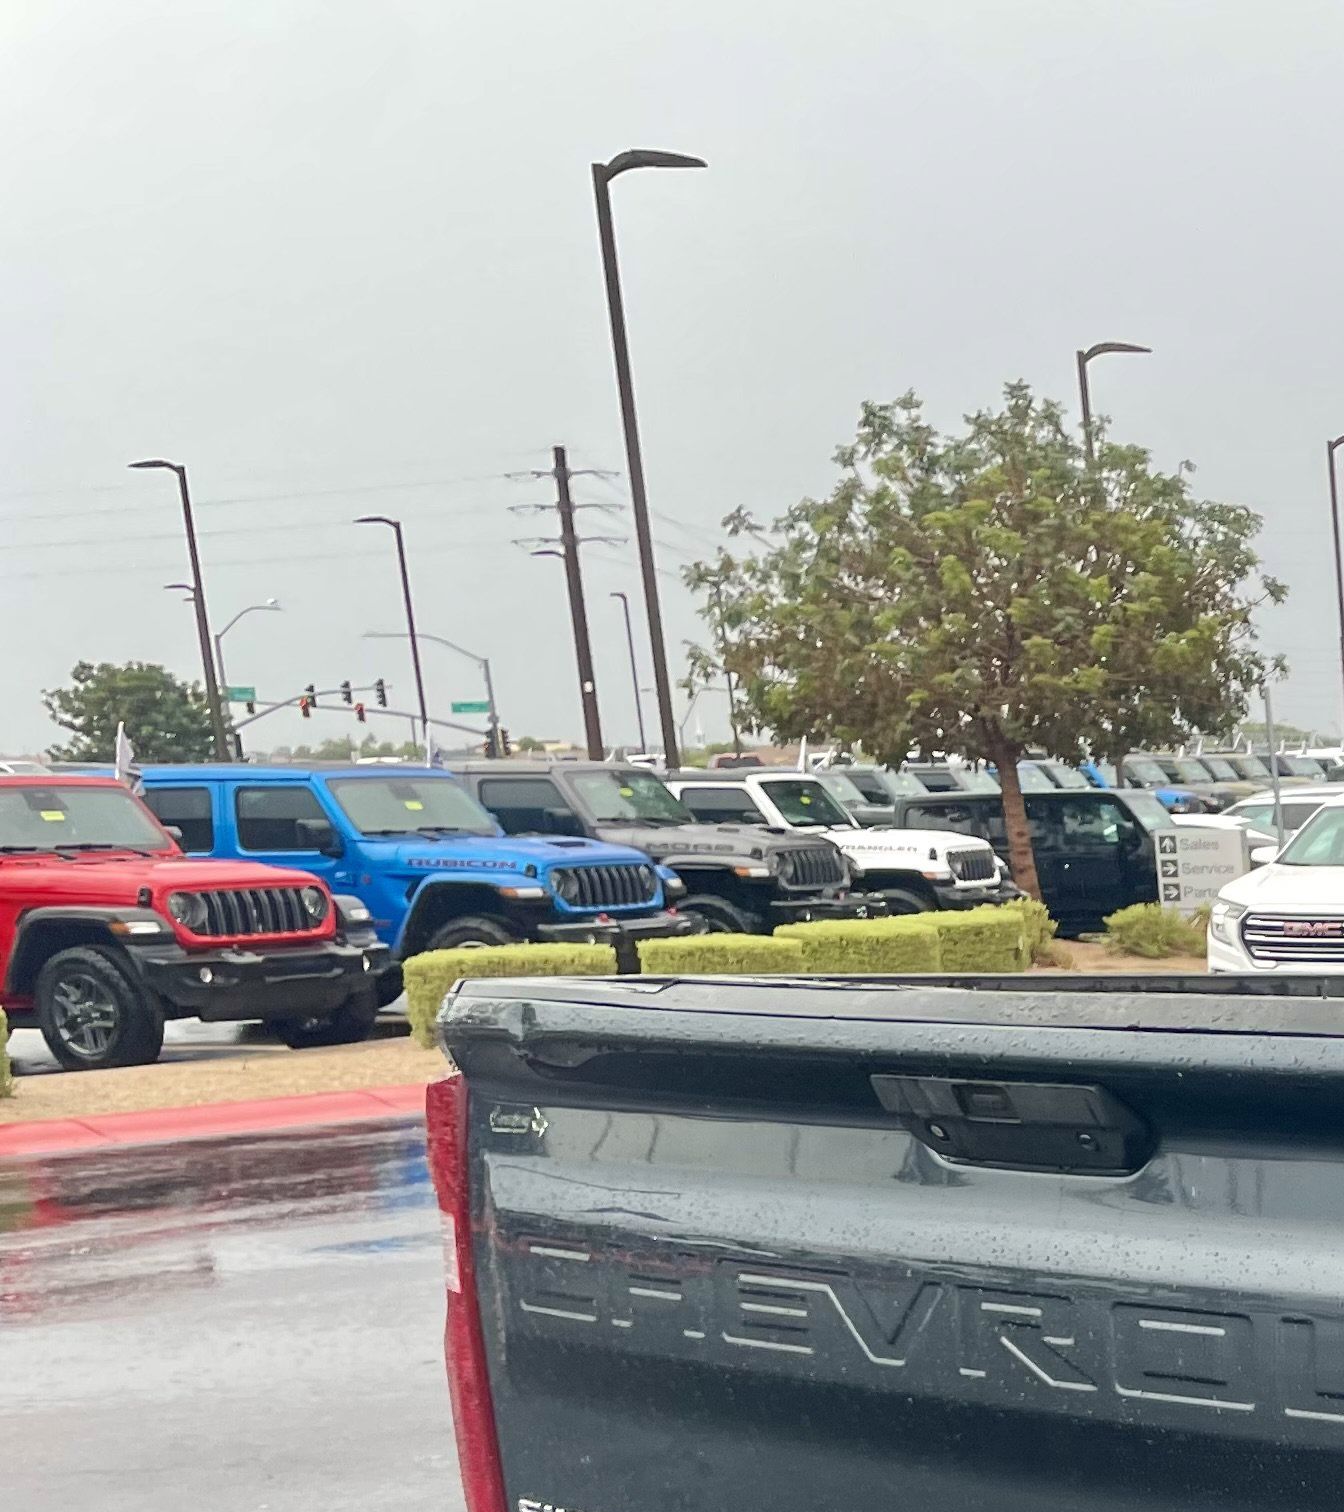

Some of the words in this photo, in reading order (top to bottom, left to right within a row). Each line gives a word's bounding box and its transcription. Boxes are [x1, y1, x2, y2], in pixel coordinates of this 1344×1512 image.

[1180, 838, 1219, 850] Sales
[407, 858, 517, 869] RUBICON
[1181, 862, 1234, 874] Service
[1284, 922, 1343, 937] GMC
